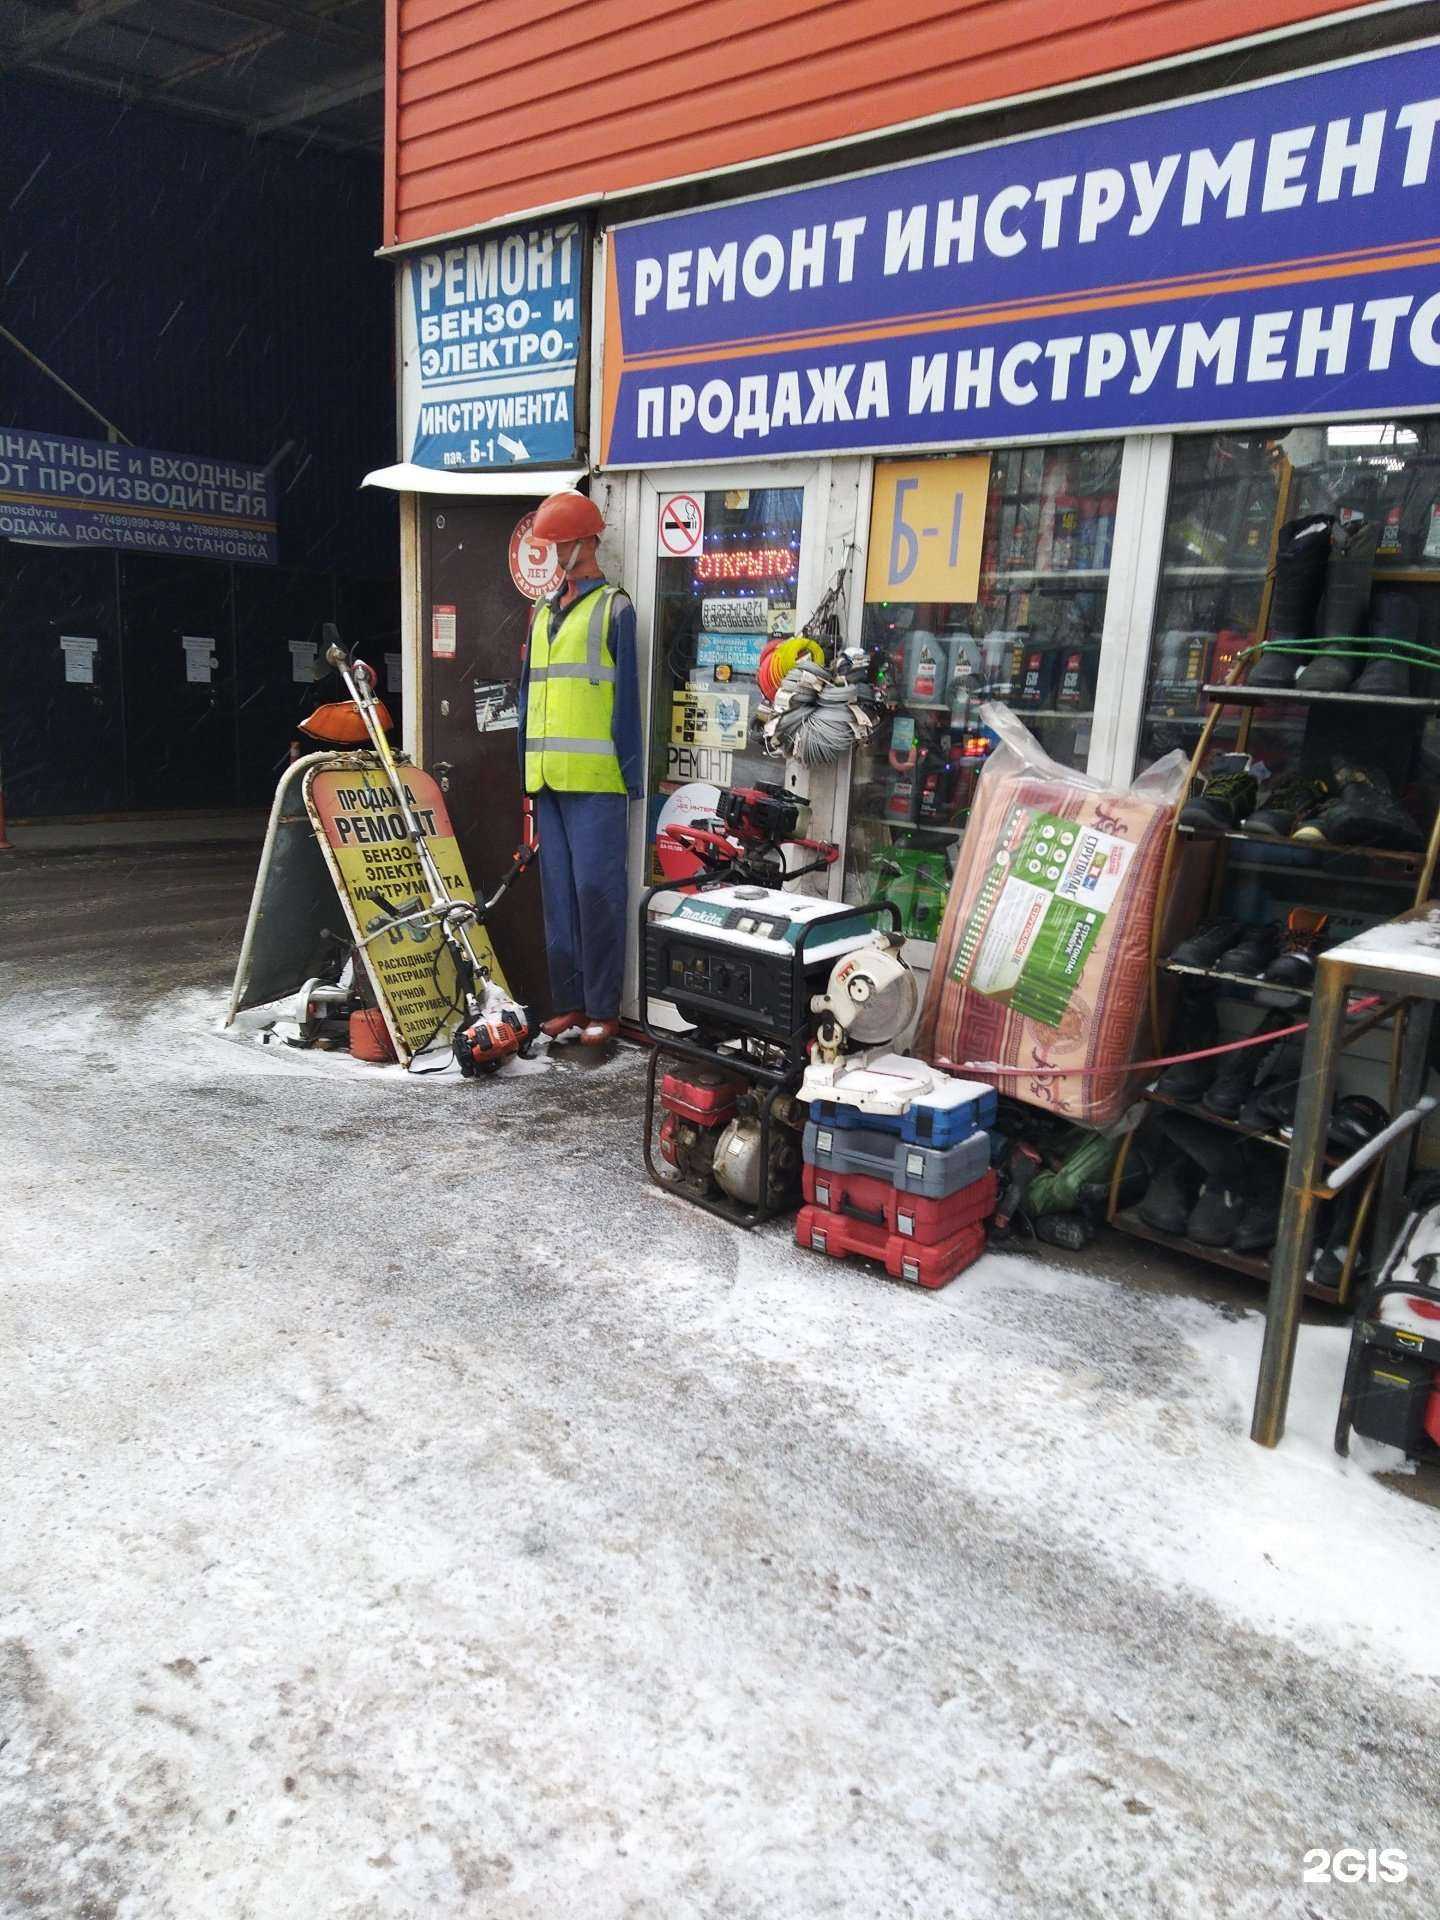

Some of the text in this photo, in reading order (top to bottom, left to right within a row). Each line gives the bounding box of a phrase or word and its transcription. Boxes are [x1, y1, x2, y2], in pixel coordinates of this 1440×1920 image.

[635, 98, 1440, 317] РЕМОНТ ИНСТРУМЕНТ
[420, 222, 579, 311] РЕМОНТ
[421, 299, 541, 343] БЕНЗО-
[421, 329, 573, 377] ЭЛЕКТРО-
[637, 292, 1440, 439] ПРОДАЖА ИНСТРУМЕНТО
[421, 391, 569, 436] ИНСТРУМЕНТА
[0, 434, 121, 472] НАТНЫЕ
[150, 456, 267, 493] ВХОДНЫЕ
[470, 438, 494, 462] Б-1
[39, 466, 268, 517] ПРОИЗВОДИТЕЛЯ
[76, 524, 169, 549] ДОСТАВКА
[175, 535, 269, 559] УСТАНОВКА
[888, 478, 964, 586] Б-1
[528, 568, 548, 578] ЛЕТ
[697, 549, 792, 578] ОТКРЫТО
[666, 747, 732, 782] РЕМОНТ
[353, 875, 465, 901] ИНСТРУМТА
[378, 952, 435, 971] РАСХОДНЫЕ
[391, 985, 427, 1002] РУЧНОЙ
